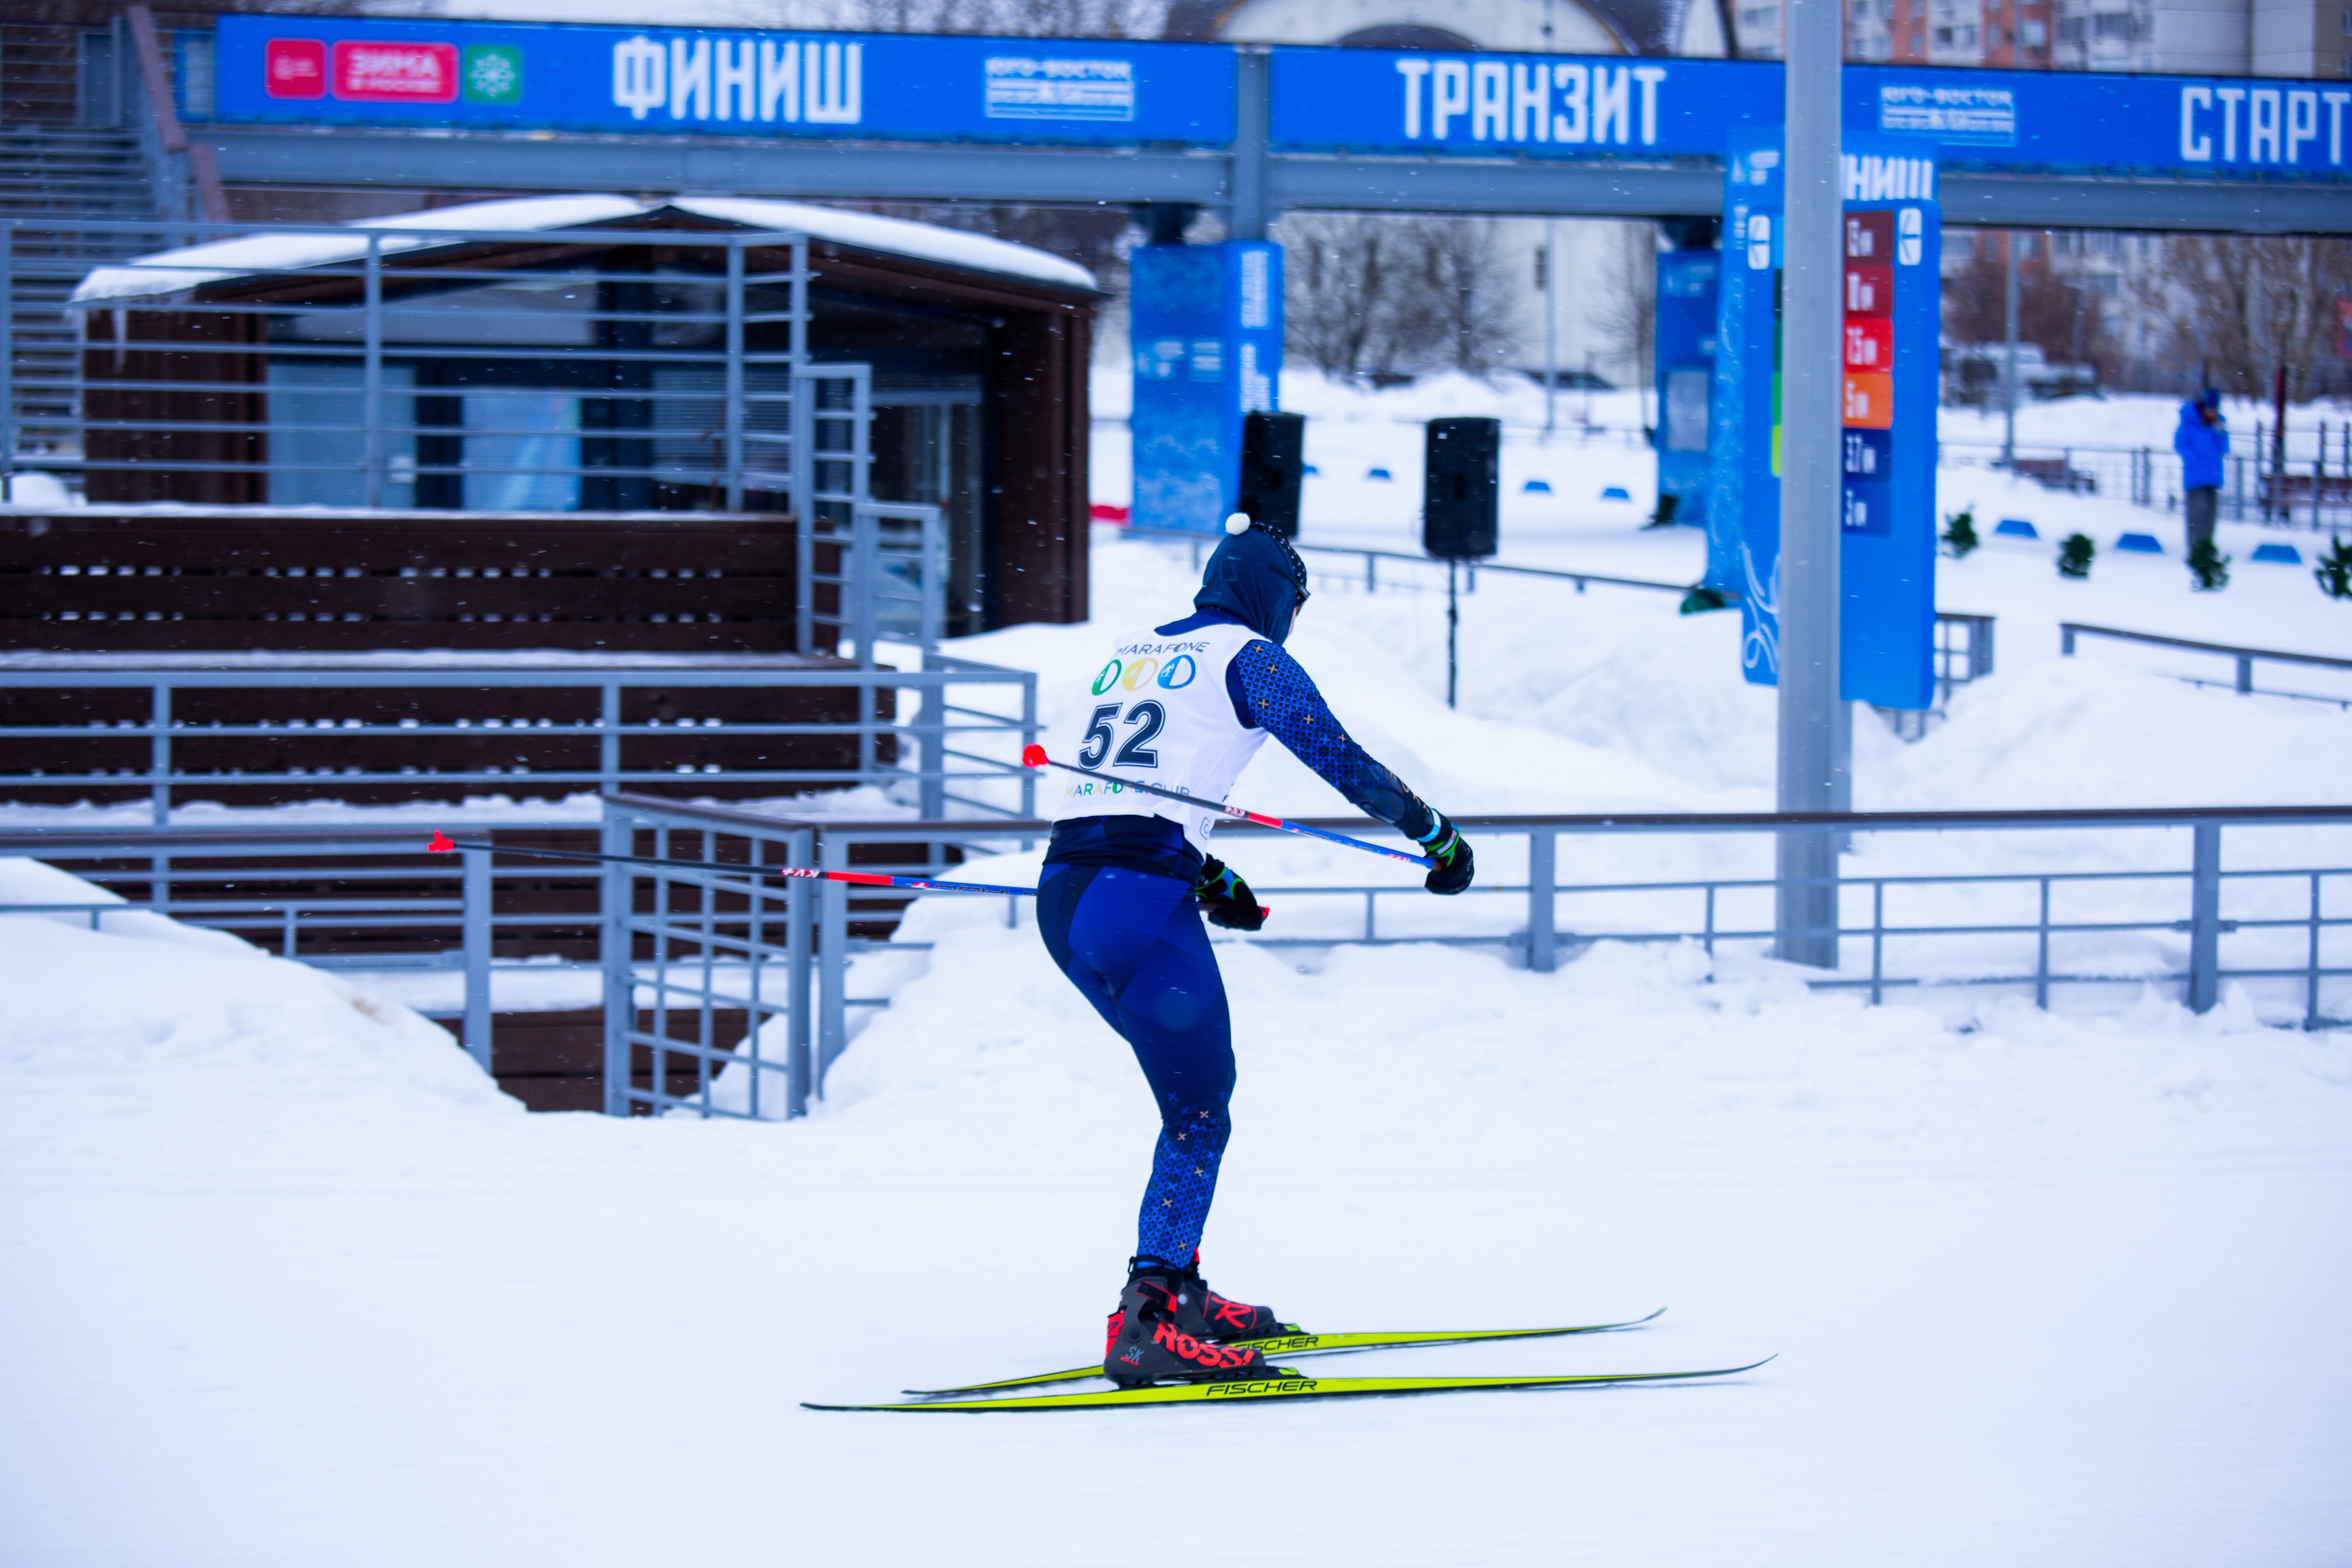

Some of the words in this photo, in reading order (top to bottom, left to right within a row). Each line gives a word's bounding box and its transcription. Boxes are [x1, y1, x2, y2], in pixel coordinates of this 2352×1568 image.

[347, 50, 442, 76] ЗИМА
[613, 35, 862, 124] ФИНИШ
[1396, 59, 1667, 145] ТРАНЗИТ
[2181, 86, 2351, 165] СТАРТ
[1841, 153, 1933, 200] НИШ
[1116, 642, 1211, 656] MARAFONE
[1079, 699, 1165, 770] 52
[1206, 1381, 1317, 1397] FISCHER
